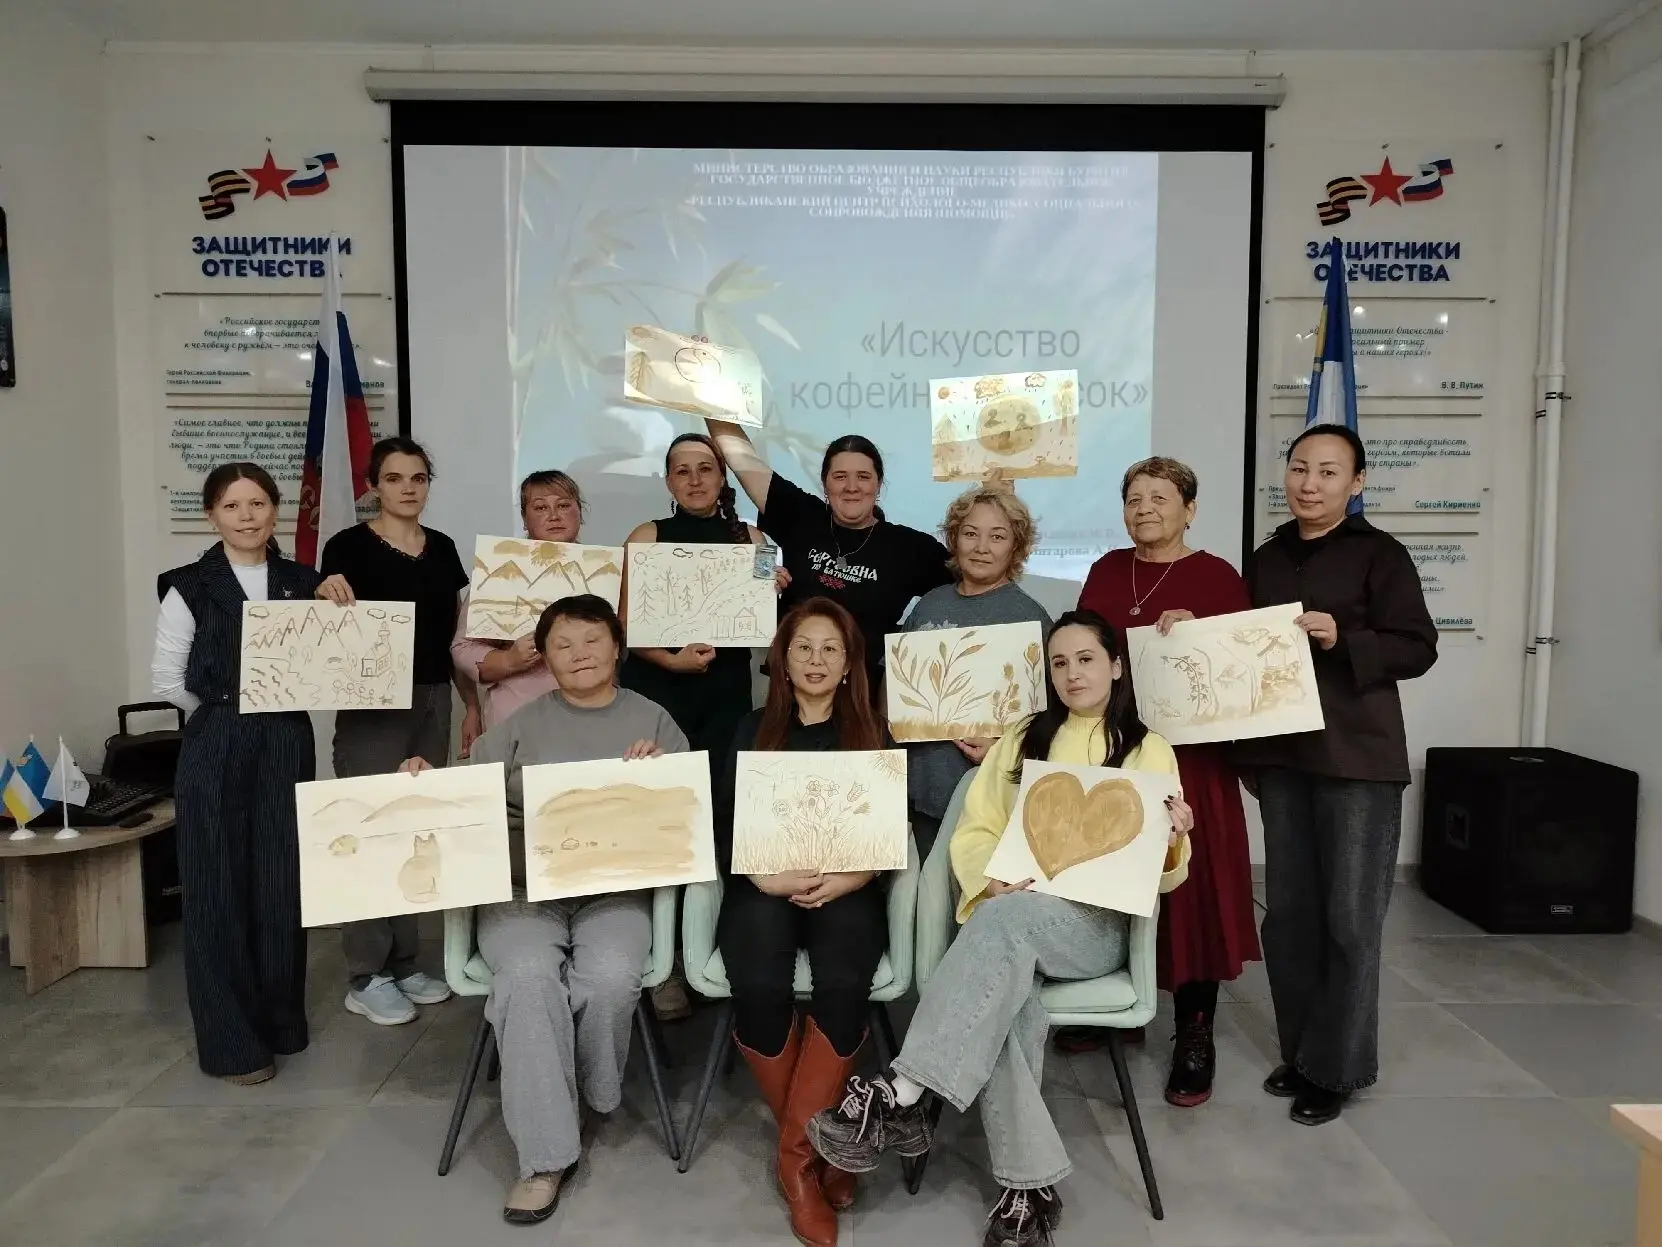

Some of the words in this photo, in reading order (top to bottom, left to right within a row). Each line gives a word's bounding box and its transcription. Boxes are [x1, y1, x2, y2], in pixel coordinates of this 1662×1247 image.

[191, 236, 352, 257] ЗАЩИТНИКИ
[1306, 241, 1461, 261] ЗАЩИТНИКИ
[201, 259, 344, 278] ОТЕЧЕСТВ
[1314, 264, 1450, 281] ОЕЧЕСТВА
[275, 318, 320, 329] государст
[861, 320, 1080, 366] «Искусство
[790, 371, 931, 418] кофейн
[1078, 378, 1149, 410] сок»
[1459, 381, 1484, 391] Путин
